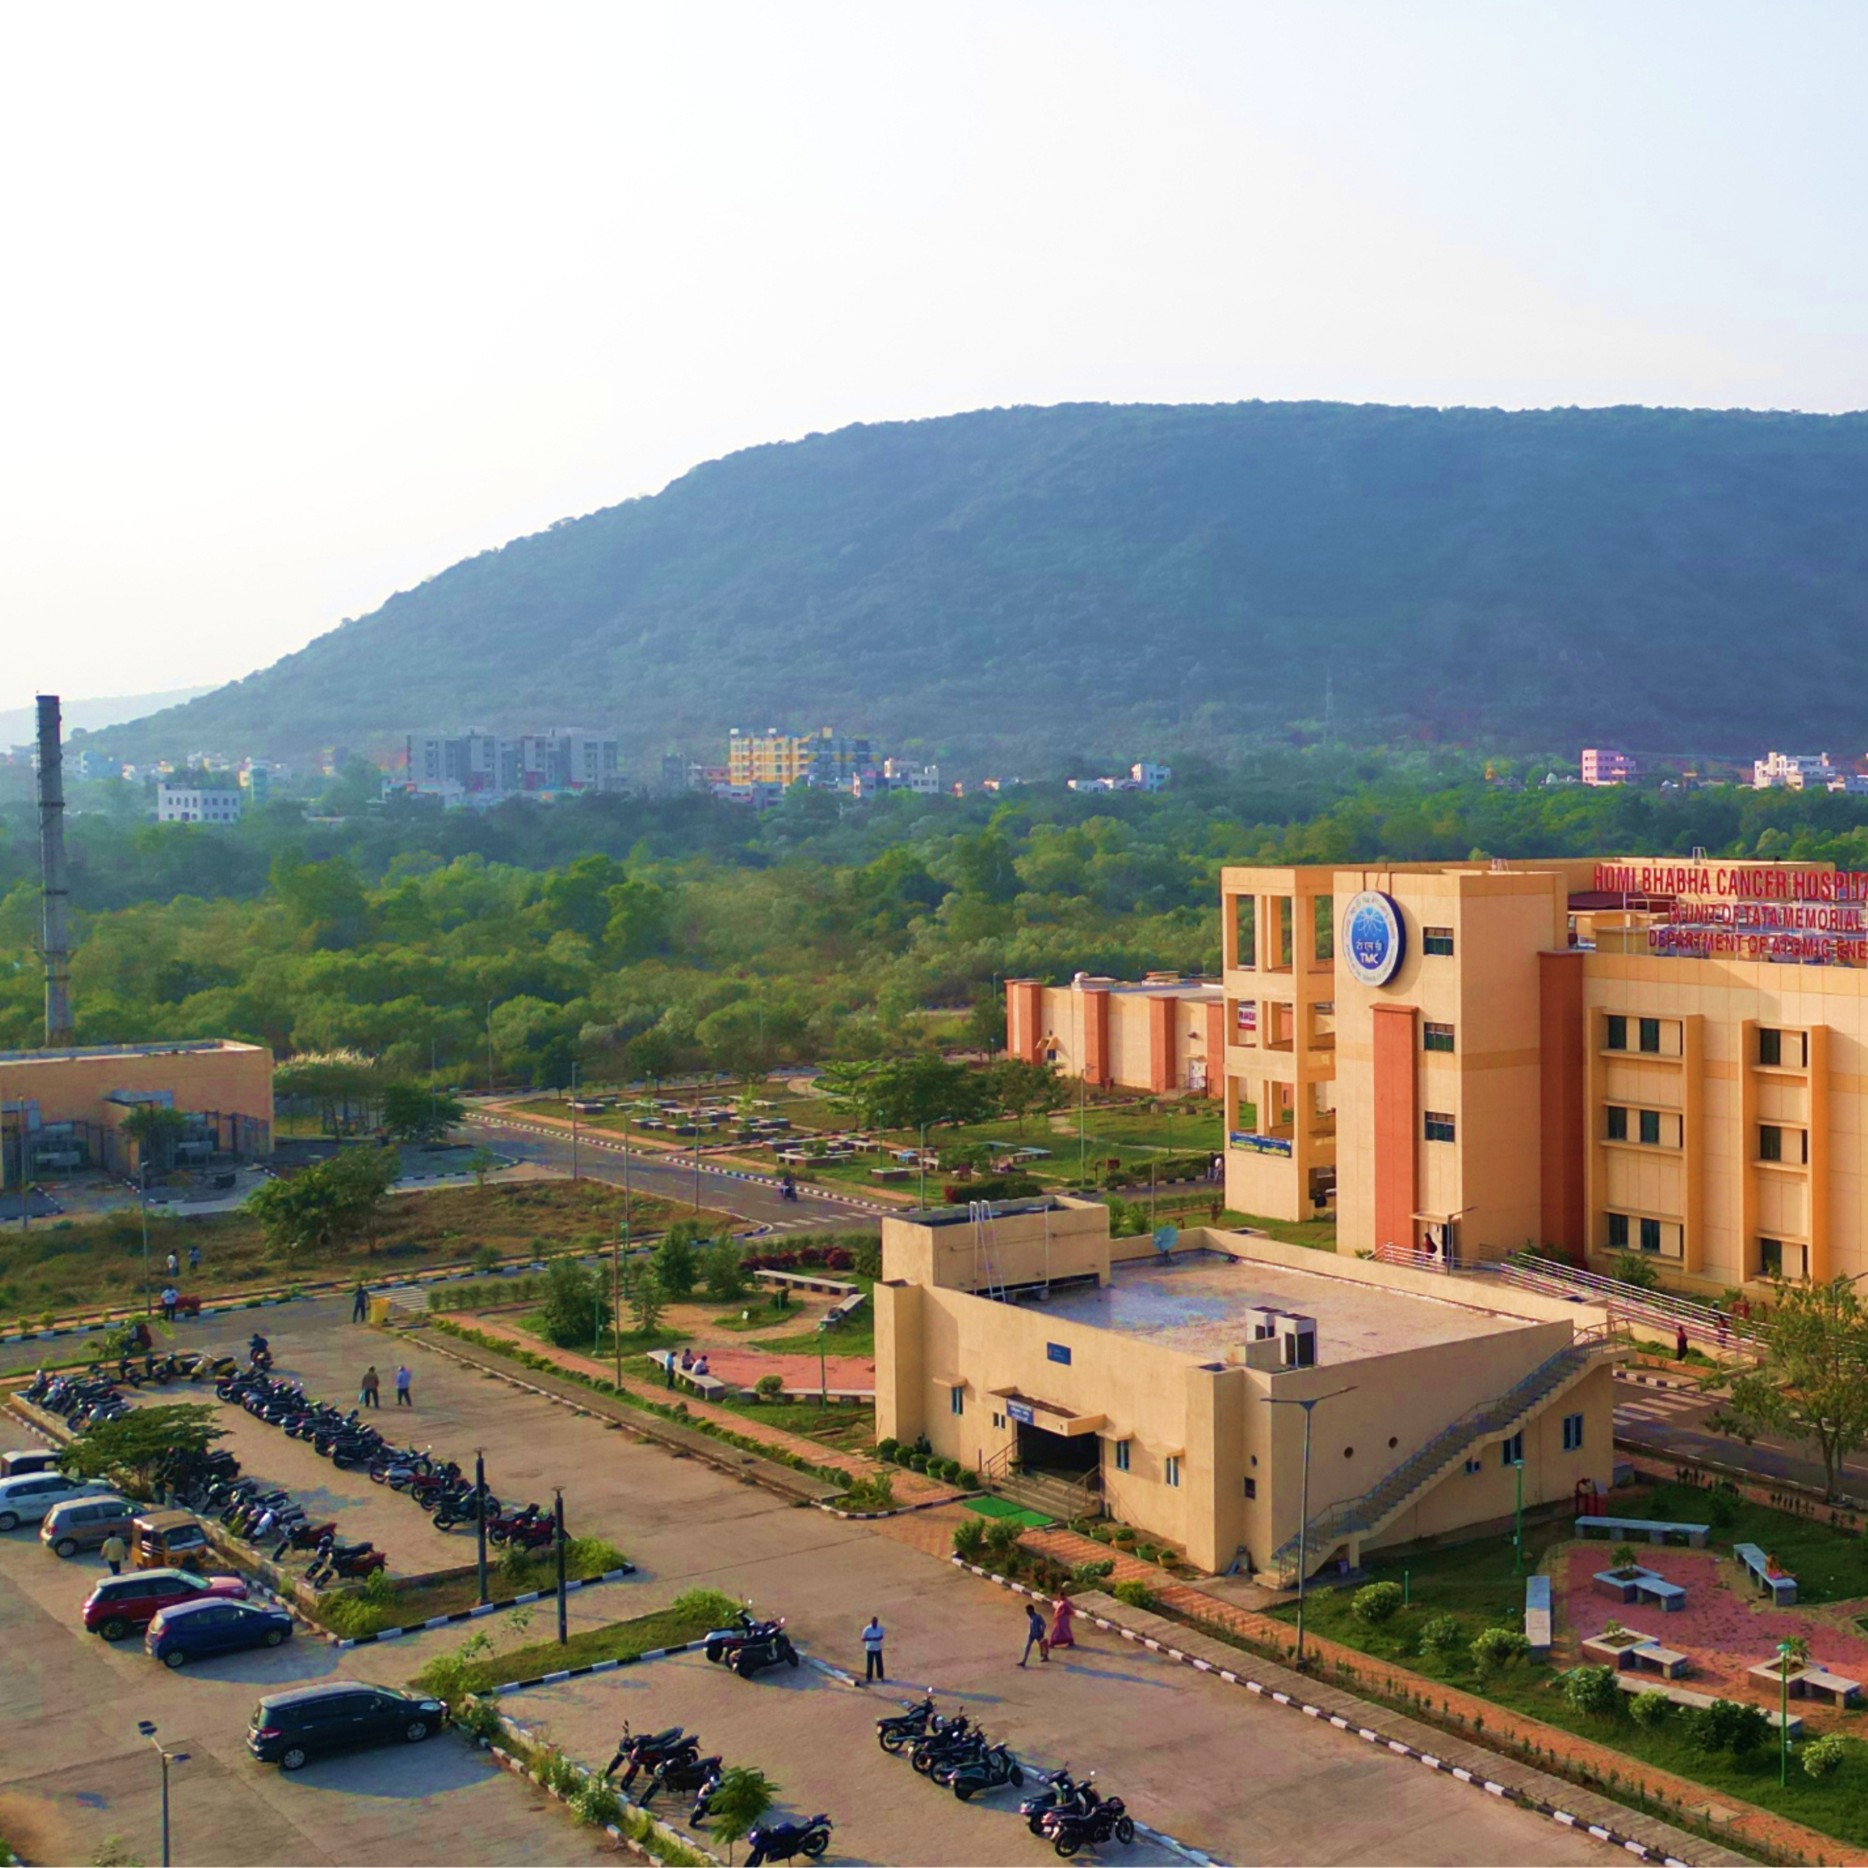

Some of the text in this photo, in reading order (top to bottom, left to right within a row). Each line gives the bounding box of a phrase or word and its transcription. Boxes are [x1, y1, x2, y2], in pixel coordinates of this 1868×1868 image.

[1594, 865, 1636, 892] HOMI
[1642, 866, 1711, 895] BHABHA
[1716, 868, 1787, 898] CANCER
[1686, 903, 1716, 924] UNIT
[1722, 903, 1740, 926] OF
[1744, 905, 1779, 926] TATA
[1783, 906, 1864, 932] MEMORIAL
[1649, 929, 1742, 953] DEPARTMENT
[1748, 934, 1768, 955] OF
[1772, 935, 1831, 958] ATOMIC
[1359, 952, 1379, 965] TMC
